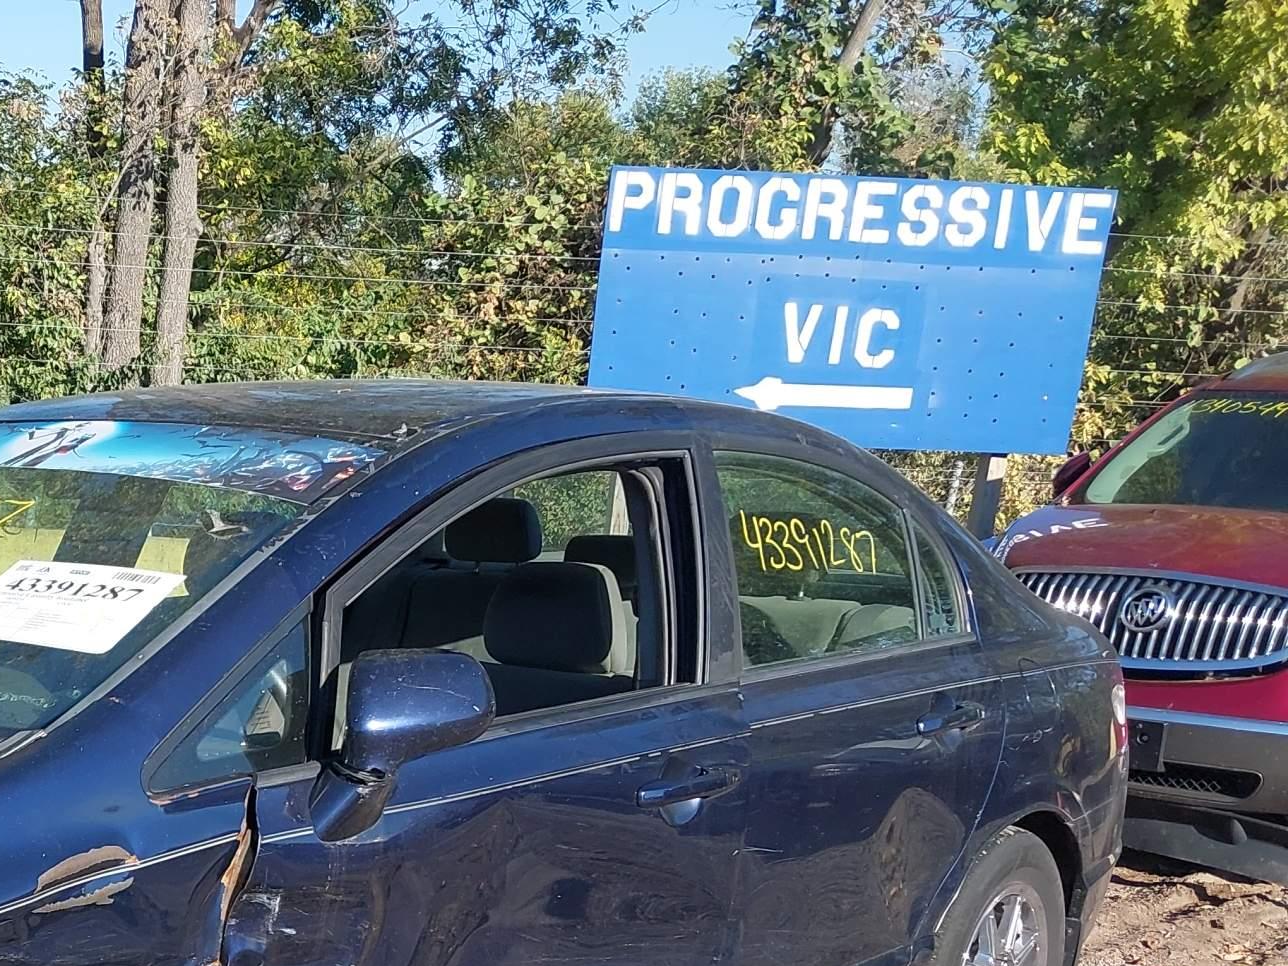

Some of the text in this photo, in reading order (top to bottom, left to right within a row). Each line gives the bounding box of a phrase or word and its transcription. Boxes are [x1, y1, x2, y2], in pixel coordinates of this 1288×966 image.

[608, 169, 1113, 255] PROGRESSIVE
[783, 301, 901, 370] VIC
[738, 508, 877, 575] 43391287
[5, 576, 145, 602] 43391287
